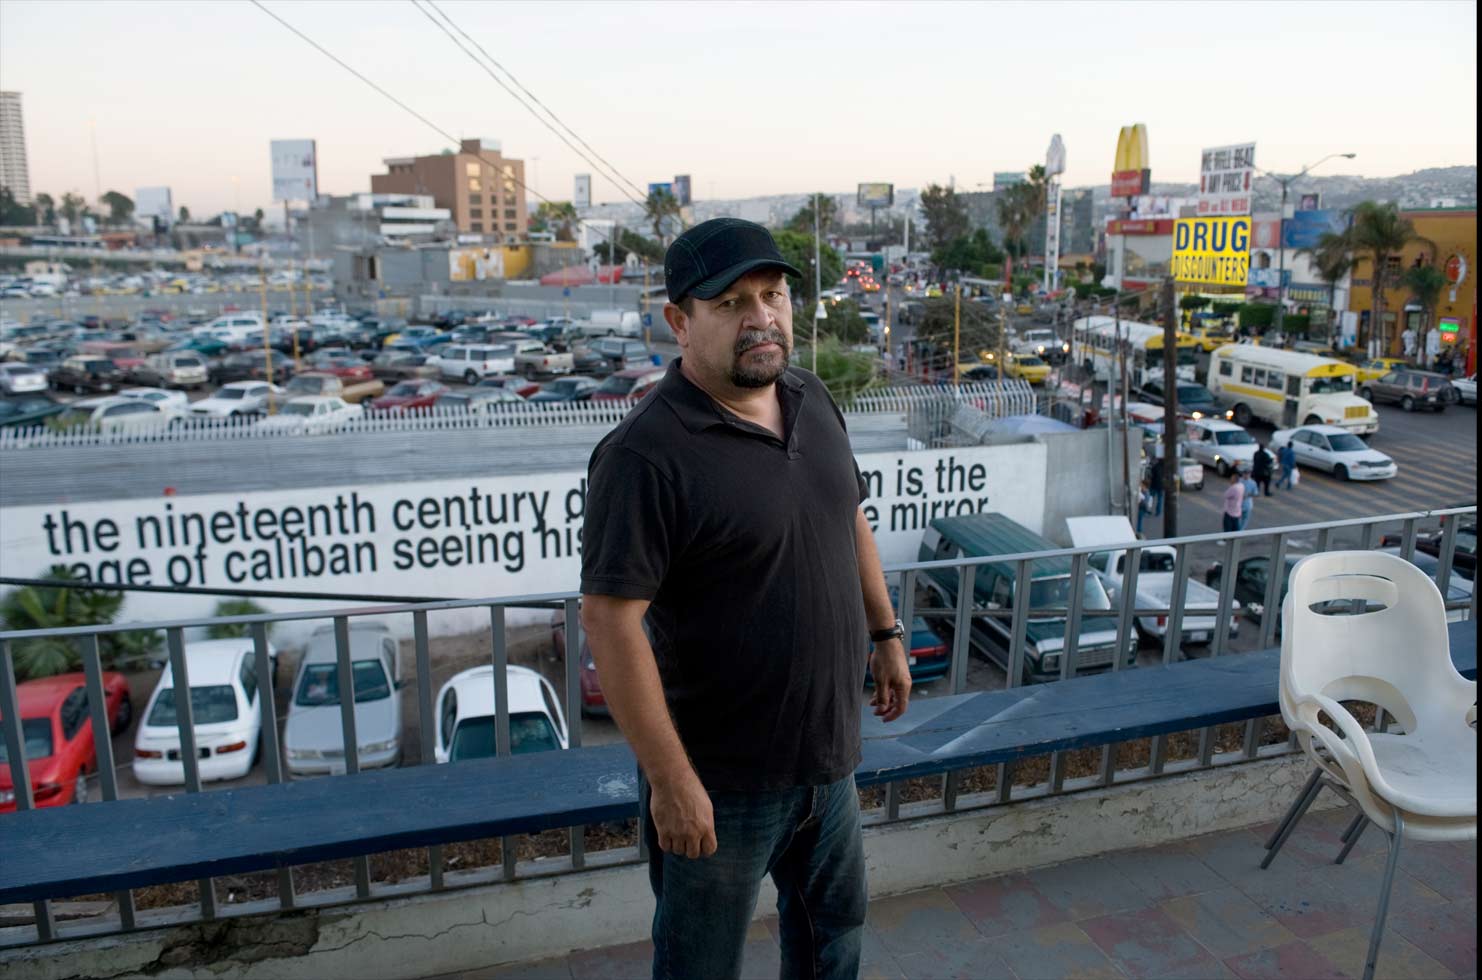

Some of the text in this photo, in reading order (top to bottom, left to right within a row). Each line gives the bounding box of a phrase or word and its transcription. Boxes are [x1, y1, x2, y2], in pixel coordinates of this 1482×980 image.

[1233, 146, 1255, 169] BEAT
[1175, 220, 1248, 252] DRUG
[1174, 255, 1246, 282] DISCOUNTERS
[43, 510, 120, 556] the
[136, 492, 376, 549] nineteenth
[392, 487, 549, 534] century
[565, 478, 587, 519] d
[897, 458, 923, 496] is
[935, 456, 986, 493] the
[168, 543, 207, 588] of
[225, 535, 377, 583] caliban
[393, 523, 524, 573] seeing
[891, 492, 988, 531] mirror
